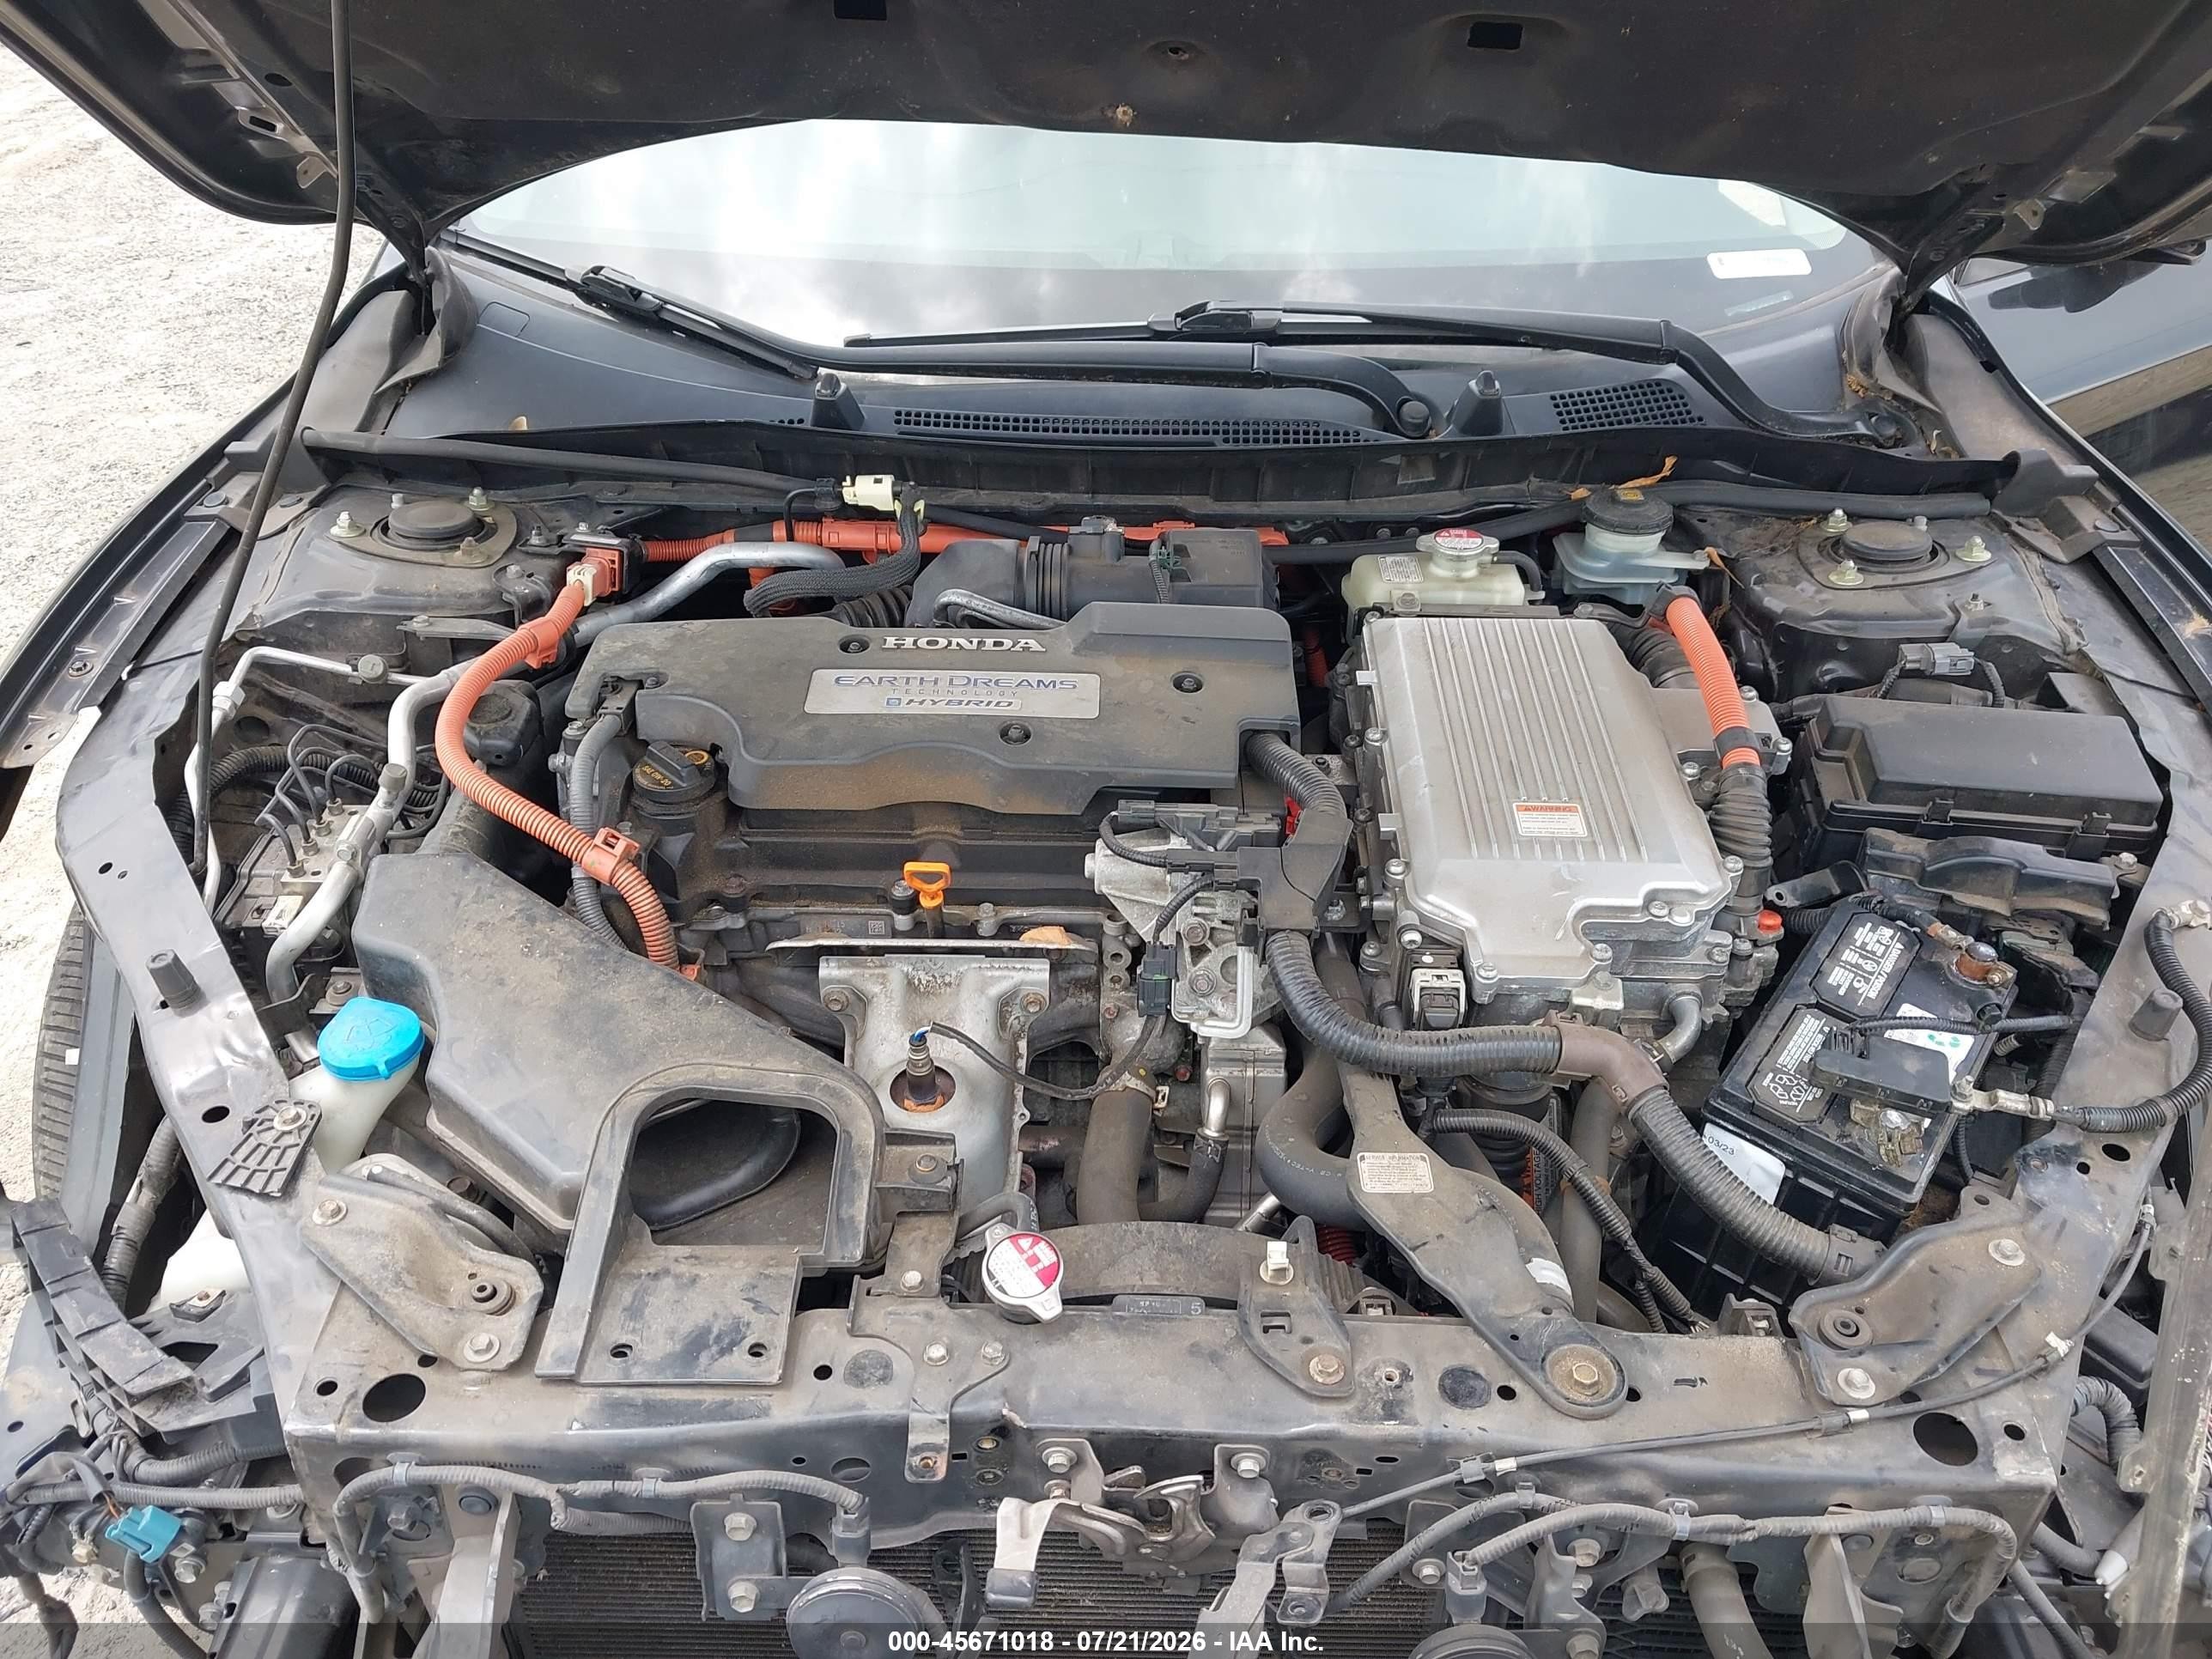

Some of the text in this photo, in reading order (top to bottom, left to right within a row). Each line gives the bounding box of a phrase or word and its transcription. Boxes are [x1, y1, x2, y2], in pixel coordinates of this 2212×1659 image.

[881, 636, 1047, 653] HONDA
[833, 675, 1079, 690] EARTH DREAMS
[890, 688, 1019, 697] TECHNOLOGY
[904, 698, 1016, 708] HYBRID
[641, 764, 653, 775] SAE
[1707, 1135, 1735, 1156] 03/23
[1533, 1150, 1542, 1192] VOLTAGE
[1189, 1302, 1202, 1316] 5
